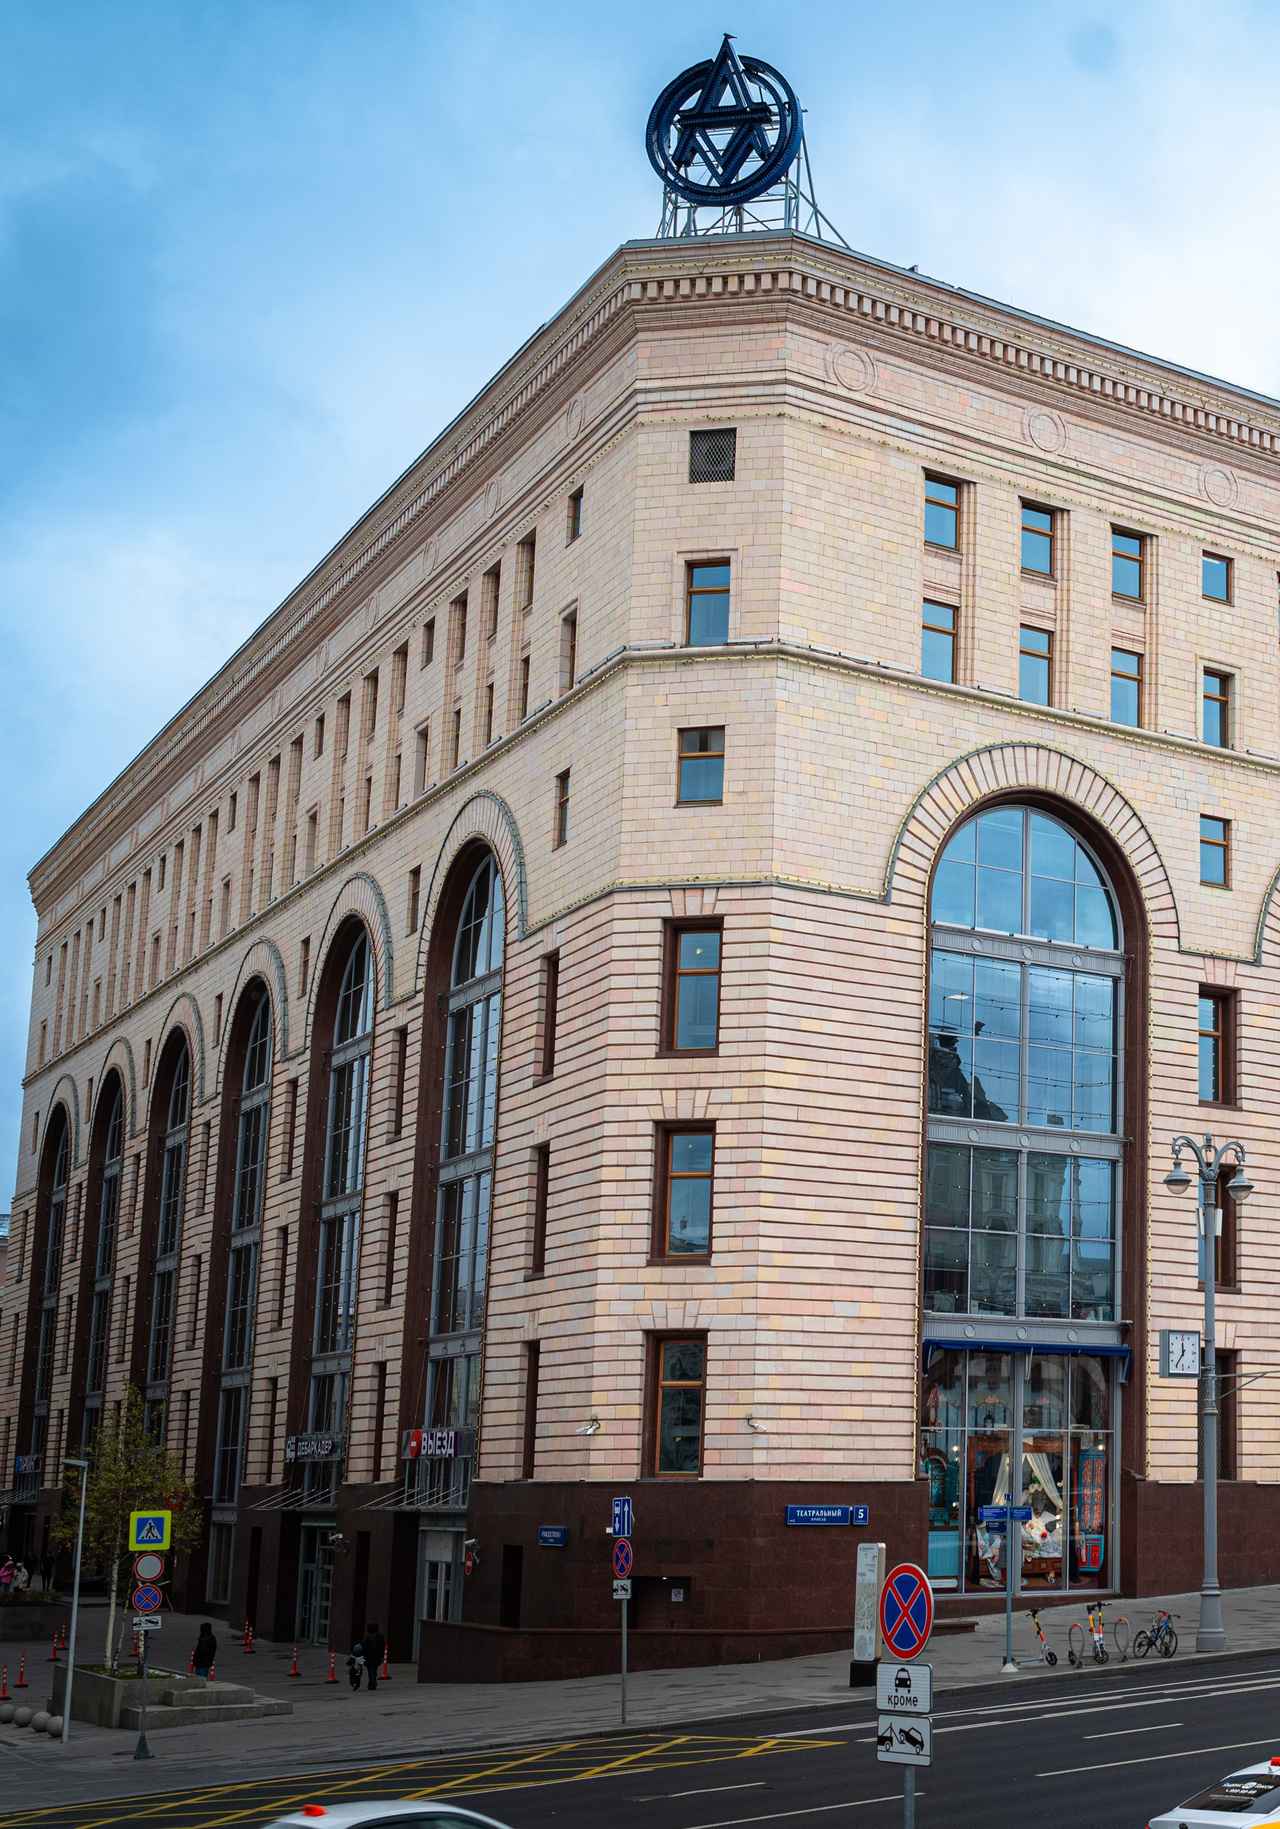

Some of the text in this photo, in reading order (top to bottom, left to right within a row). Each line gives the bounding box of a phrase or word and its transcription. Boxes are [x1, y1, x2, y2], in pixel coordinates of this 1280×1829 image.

[297, 1440, 332, 1458] ДЕБАРКАДЕР
[421, 1431, 455, 1458] ВЫЕЗД
[796, 1508, 864, 1519] ТЕАТРАЛЬНЫЙ 5
[887, 1694, 919, 1709] кроме
